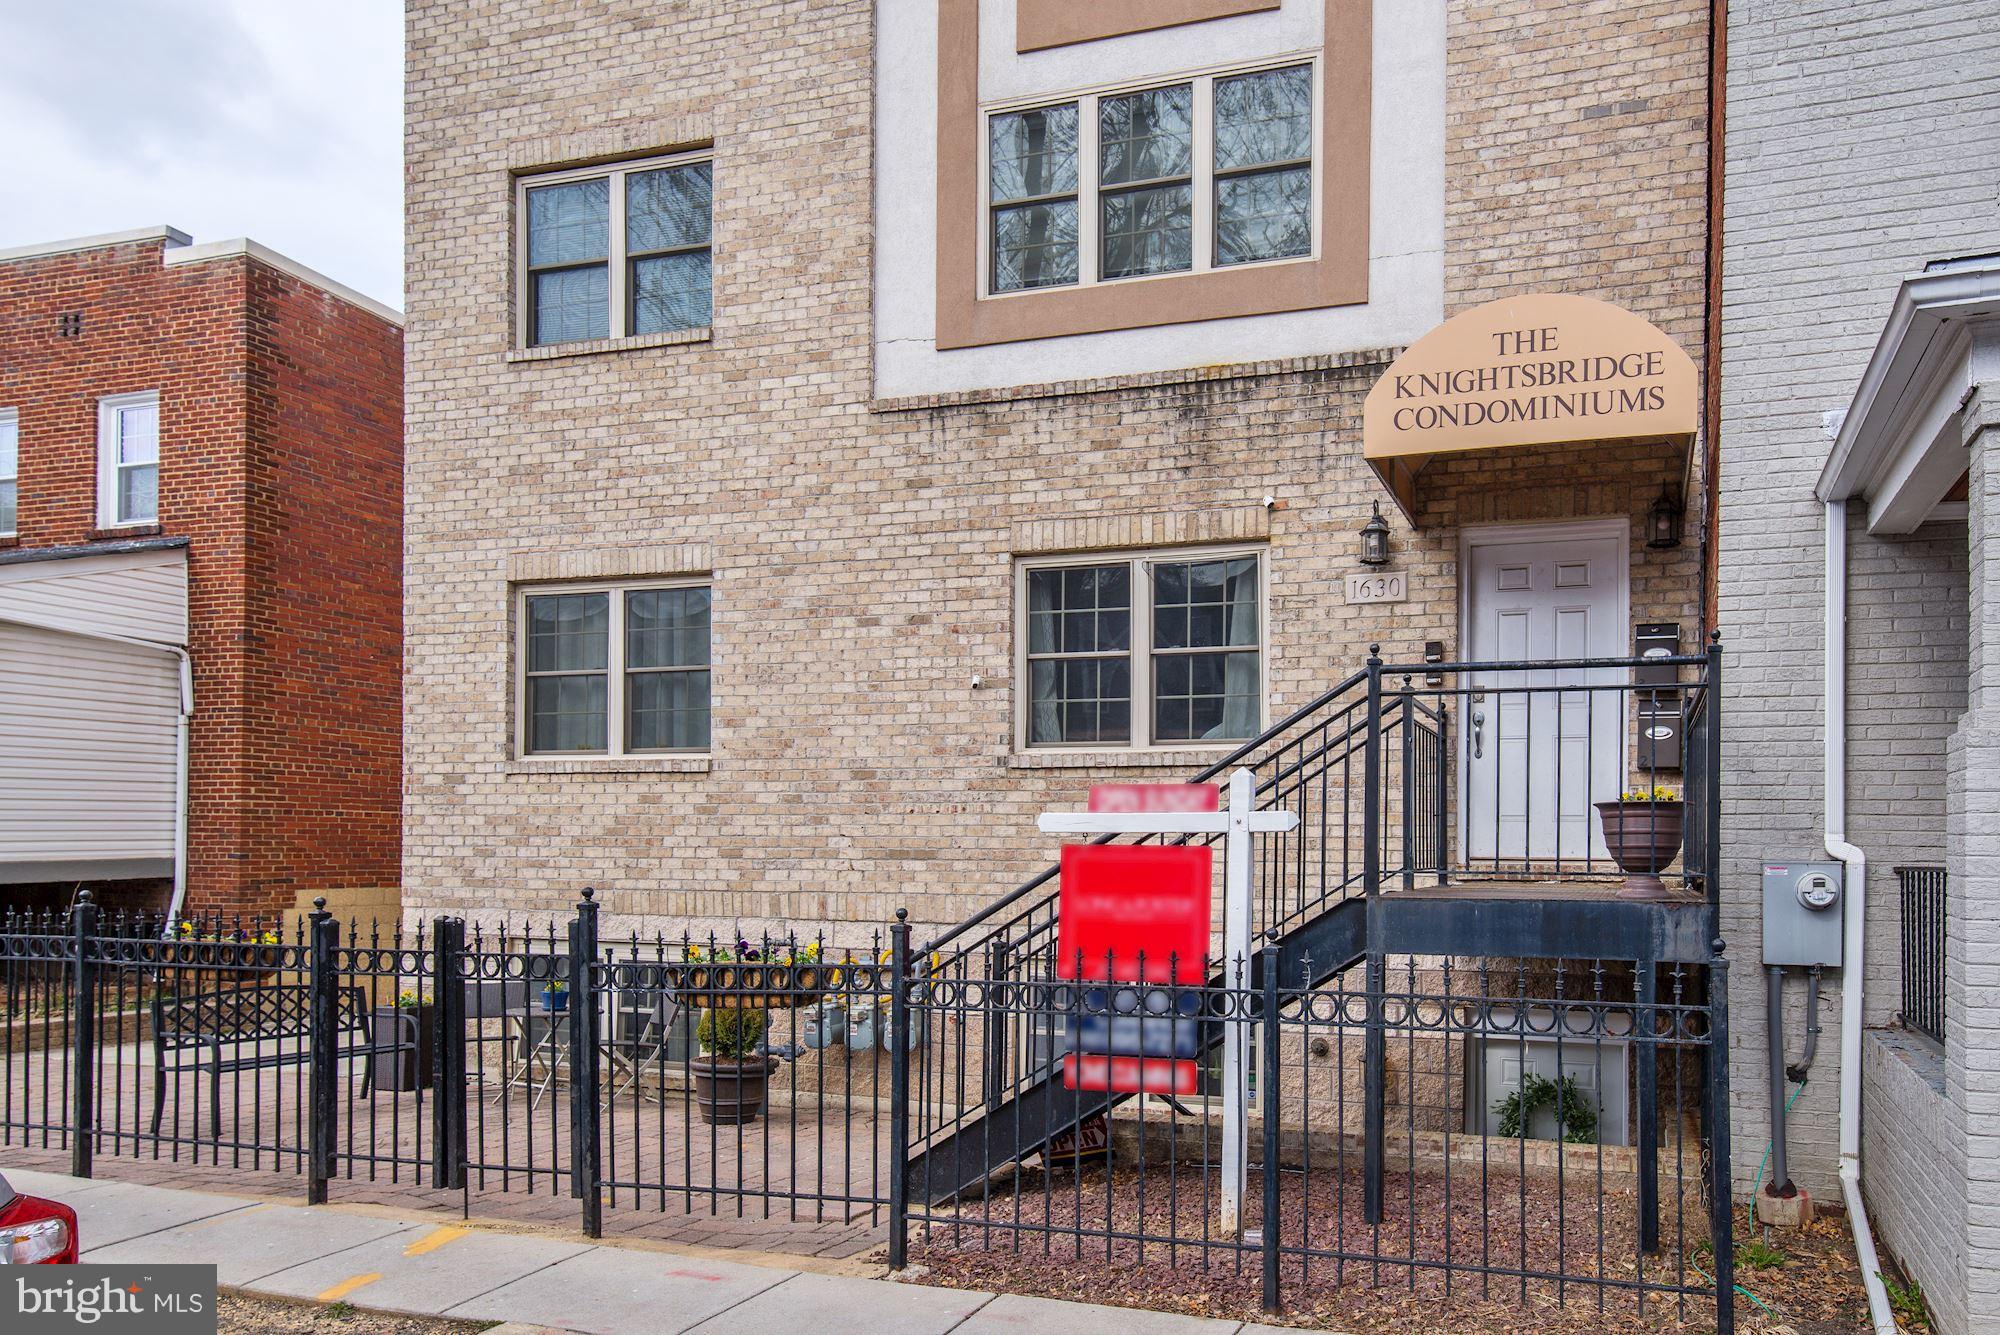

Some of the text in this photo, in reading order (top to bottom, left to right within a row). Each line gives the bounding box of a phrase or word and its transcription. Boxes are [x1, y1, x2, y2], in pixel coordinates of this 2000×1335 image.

[1491, 327, 1560, 356] THE
[1394, 350, 1666, 400] KNIGHTSBRIDGE
[1393, 385, 1665, 431] CONDOMINIUMS
[1352, 577, 1400, 600] 1630
